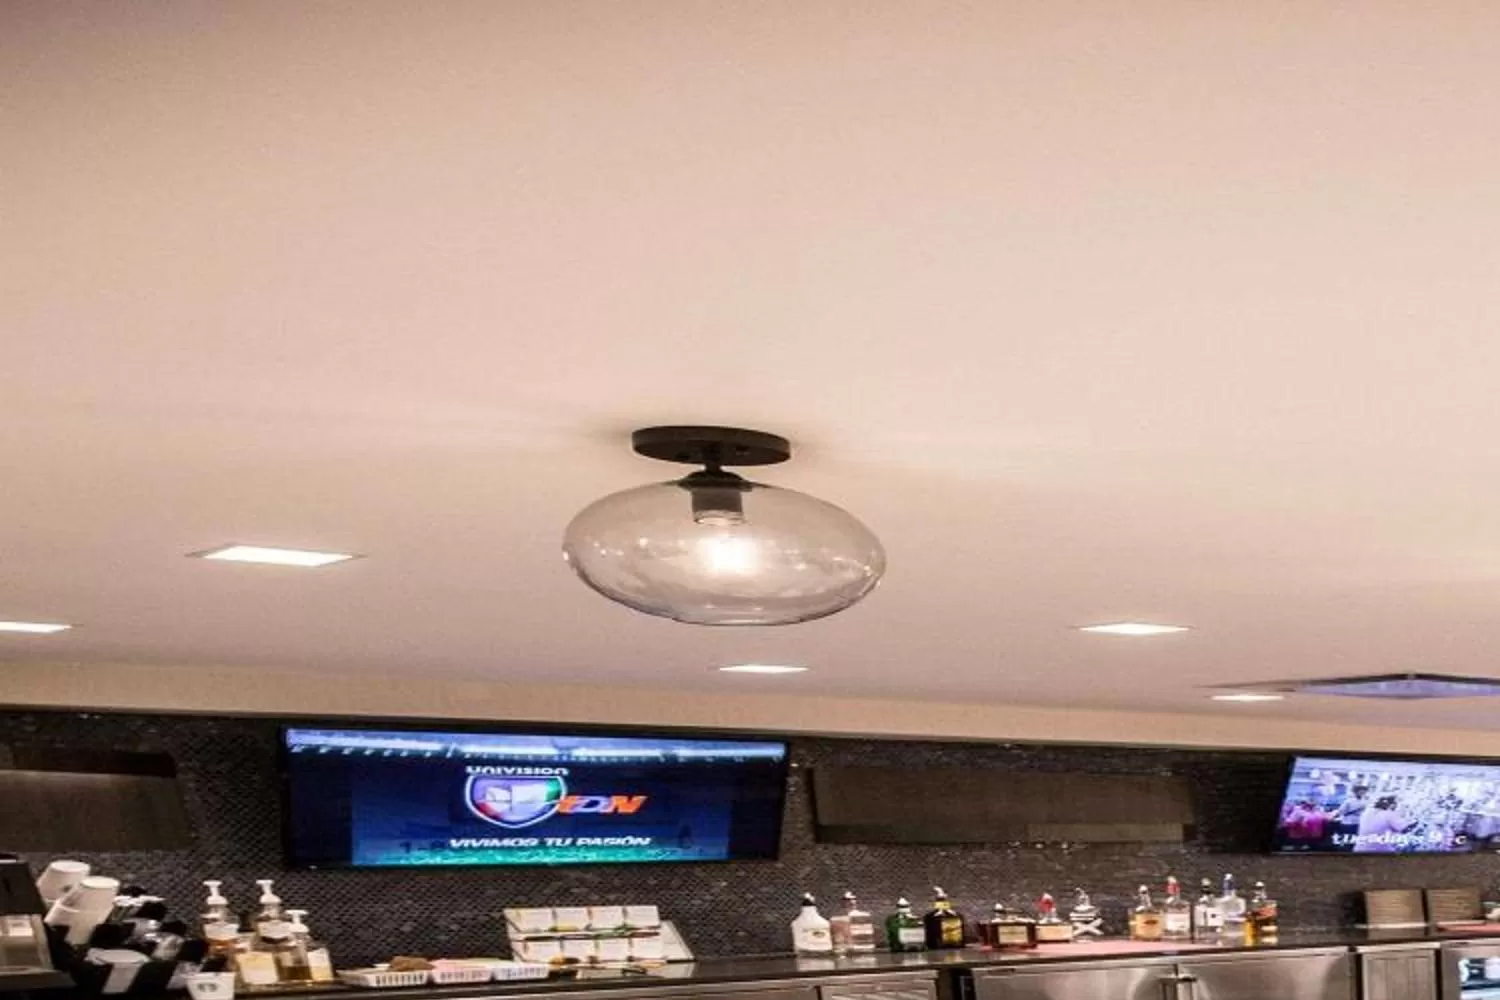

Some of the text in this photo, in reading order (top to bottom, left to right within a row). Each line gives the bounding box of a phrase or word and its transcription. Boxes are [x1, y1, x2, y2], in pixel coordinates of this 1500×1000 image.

[450, 835, 652, 848] VIVIMOS TU PASIÓN
